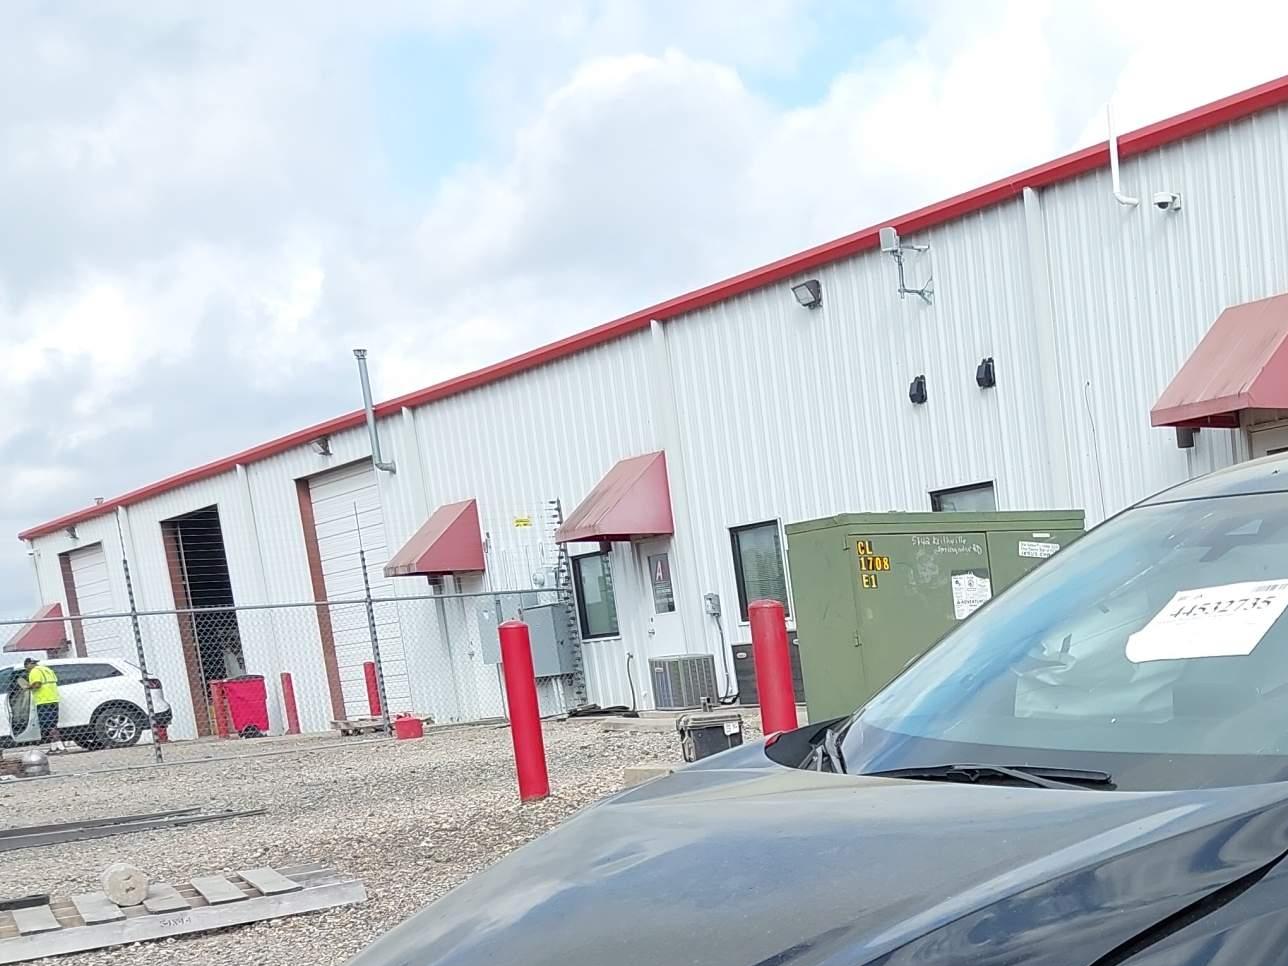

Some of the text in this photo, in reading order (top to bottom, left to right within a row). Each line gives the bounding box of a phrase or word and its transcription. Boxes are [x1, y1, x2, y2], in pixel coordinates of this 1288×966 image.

[857, 541, 873, 555] CL
[860, 557, 890, 571] 1708
[862, 574, 877, 588] E1
[1170, 596, 1277, 618] 44532735
